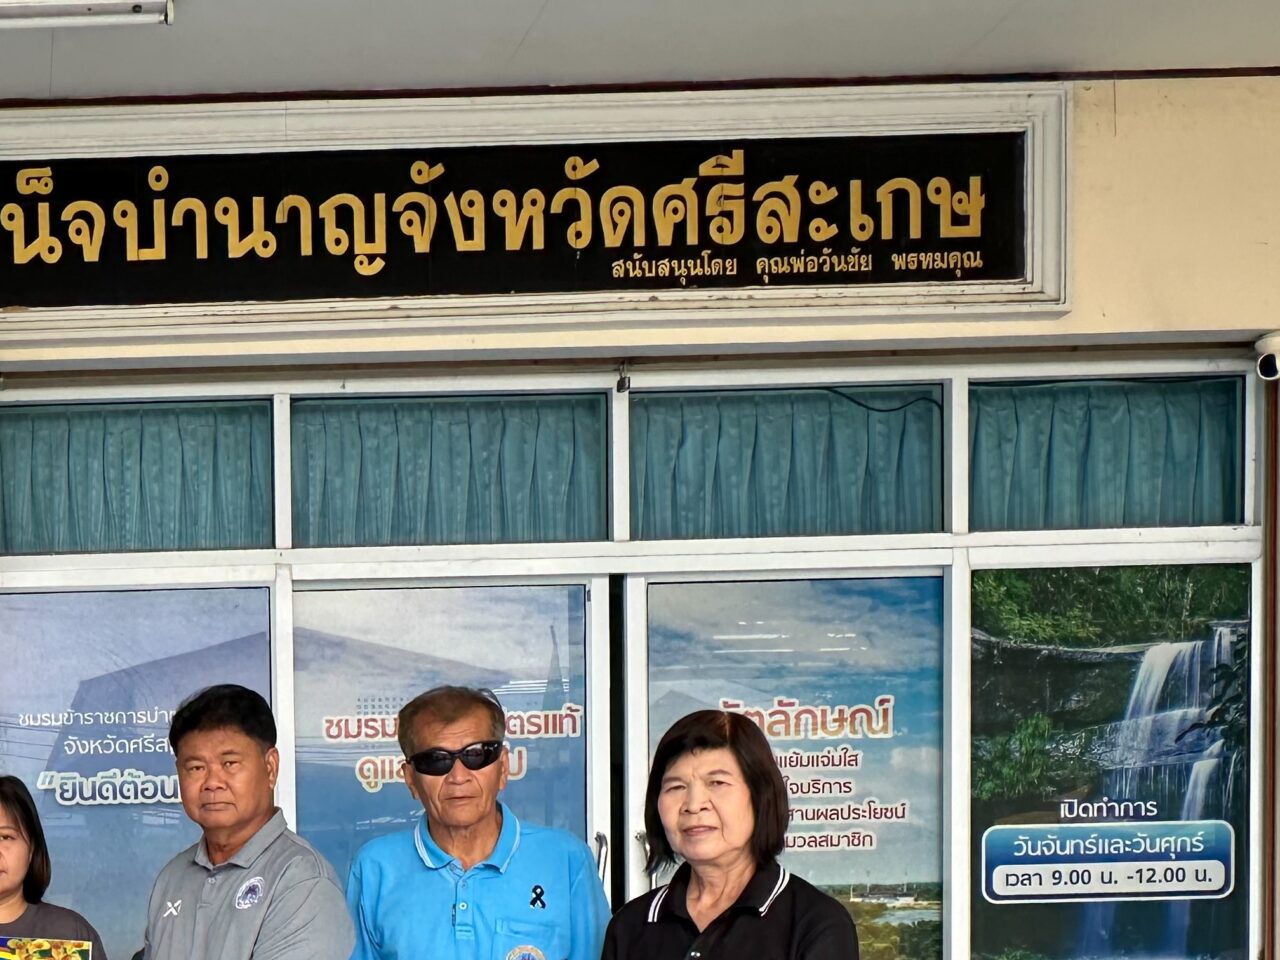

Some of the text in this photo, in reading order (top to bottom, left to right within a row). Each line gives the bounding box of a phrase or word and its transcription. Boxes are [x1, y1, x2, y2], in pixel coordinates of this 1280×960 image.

[611, 249, 737, 284] สนับสนุนโดย
[756, 246, 872, 283] คุณพ่อวันชัย
[775, 747, 858, 768] แย้มแจ่มใส
[785, 776, 852, 795] ใจบริการ
[1060, 797, 1157, 818] เปิดทำการ
[1013, 831, 1205, 859] วันจันทร์และวันศุกร์
[1005, 871, 1043, 887] เวลา
[1052, 869, 1091, 886] 9.00
[1101, 871, 1118, 885] น.
[1195, 867, 1212, 883] น.
